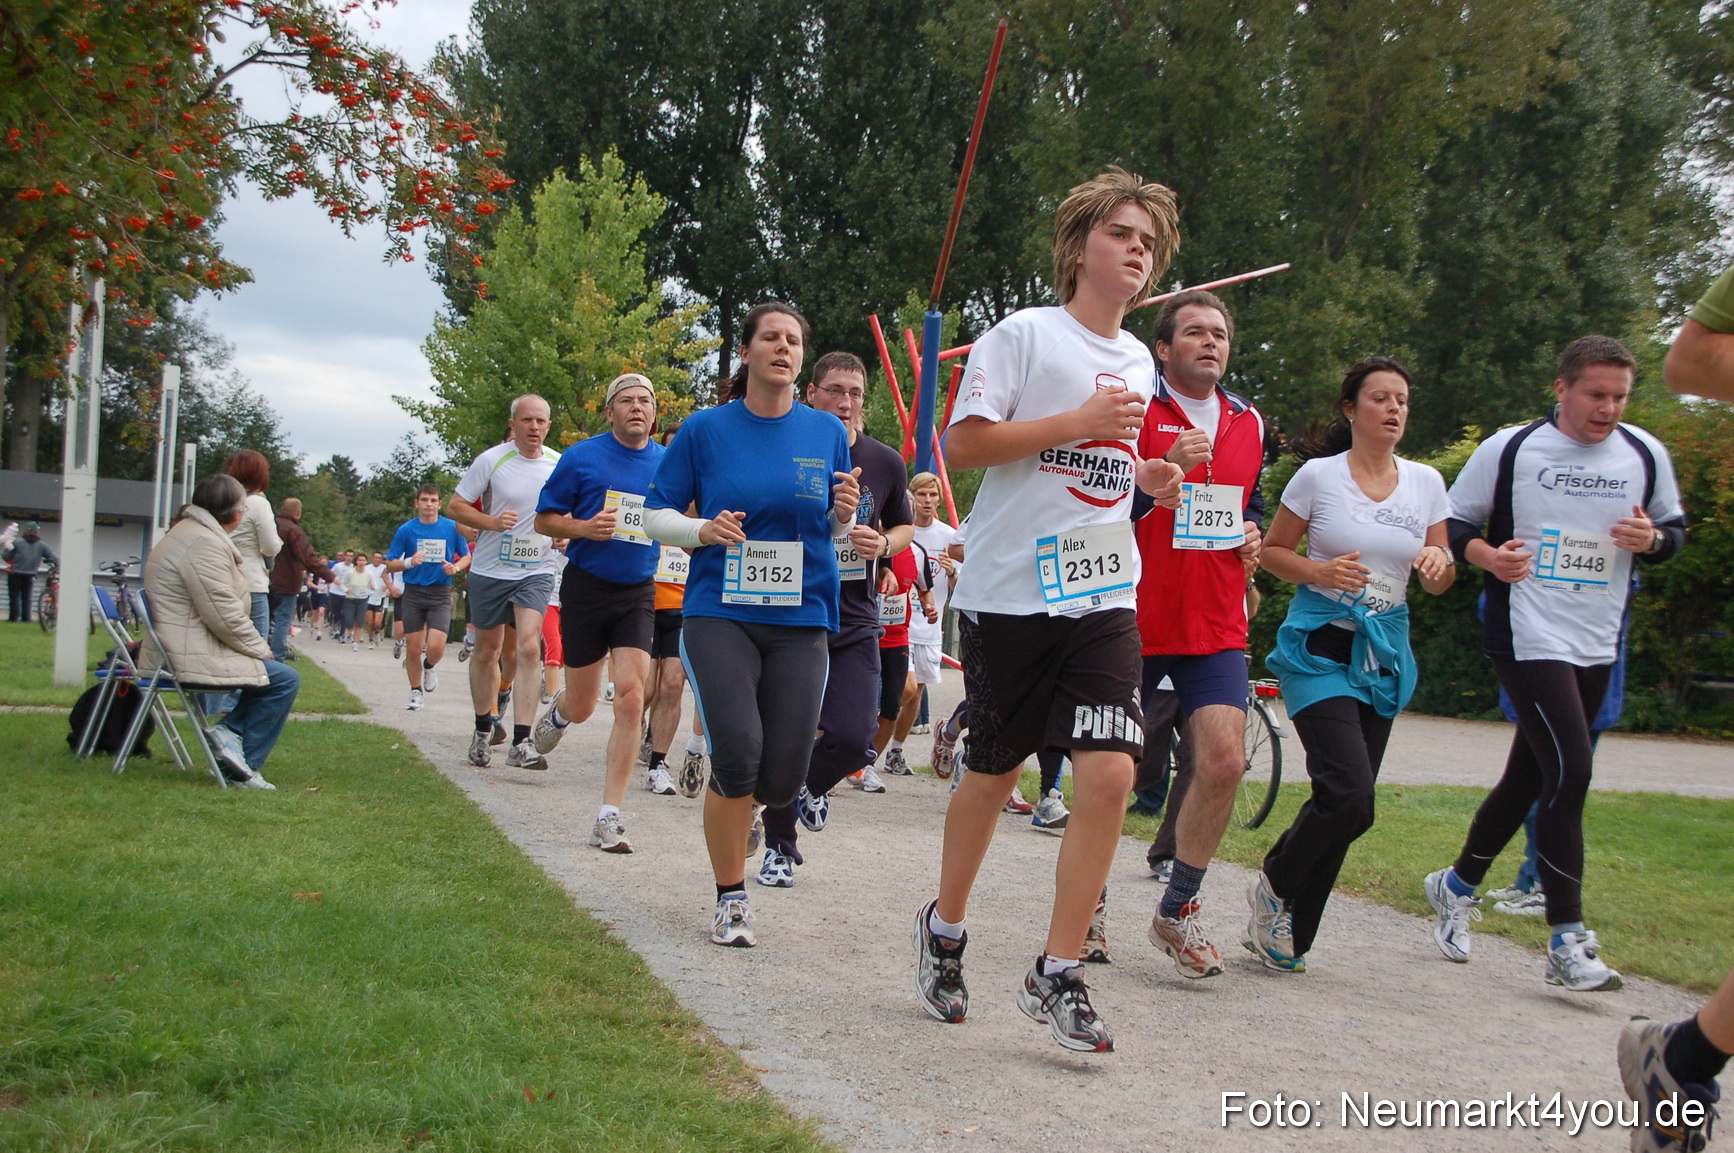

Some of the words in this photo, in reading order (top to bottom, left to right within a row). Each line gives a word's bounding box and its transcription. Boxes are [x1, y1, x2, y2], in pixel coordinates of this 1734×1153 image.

[1040, 448, 1128, 475] GERHART
[1038, 465, 1085, 478] AUTOHAUS
[1082, 472, 1131, 492] JÄNIG
[1553, 474, 1628, 490] Fischer
[1194, 490, 1213, 502] Fritz
[1563, 489, 1626, 500] Automobile
[621, 497, 642, 509] Eugen
[624, 512, 643, 527] 68
[1194, 510, 1234, 527] 2873
[1062, 538, 1086, 553] Alex
[1562, 536, 1598, 549] Karsten
[514, 547, 539, 557] 2806
[665, 550, 683, 559] Tomas
[746, 546, 777, 559] Annett
[668, 561, 687, 573] 492
[1043, 565, 1049, 576] C
[1065, 553, 1121, 582] 2313
[1560, 554, 1605, 573] 3448
[729, 563, 734, 572] C
[746, 565, 793, 583] 3152
[1100, 587, 1134, 600] PFLEIDERER
[882, 606, 904, 615] 2609
